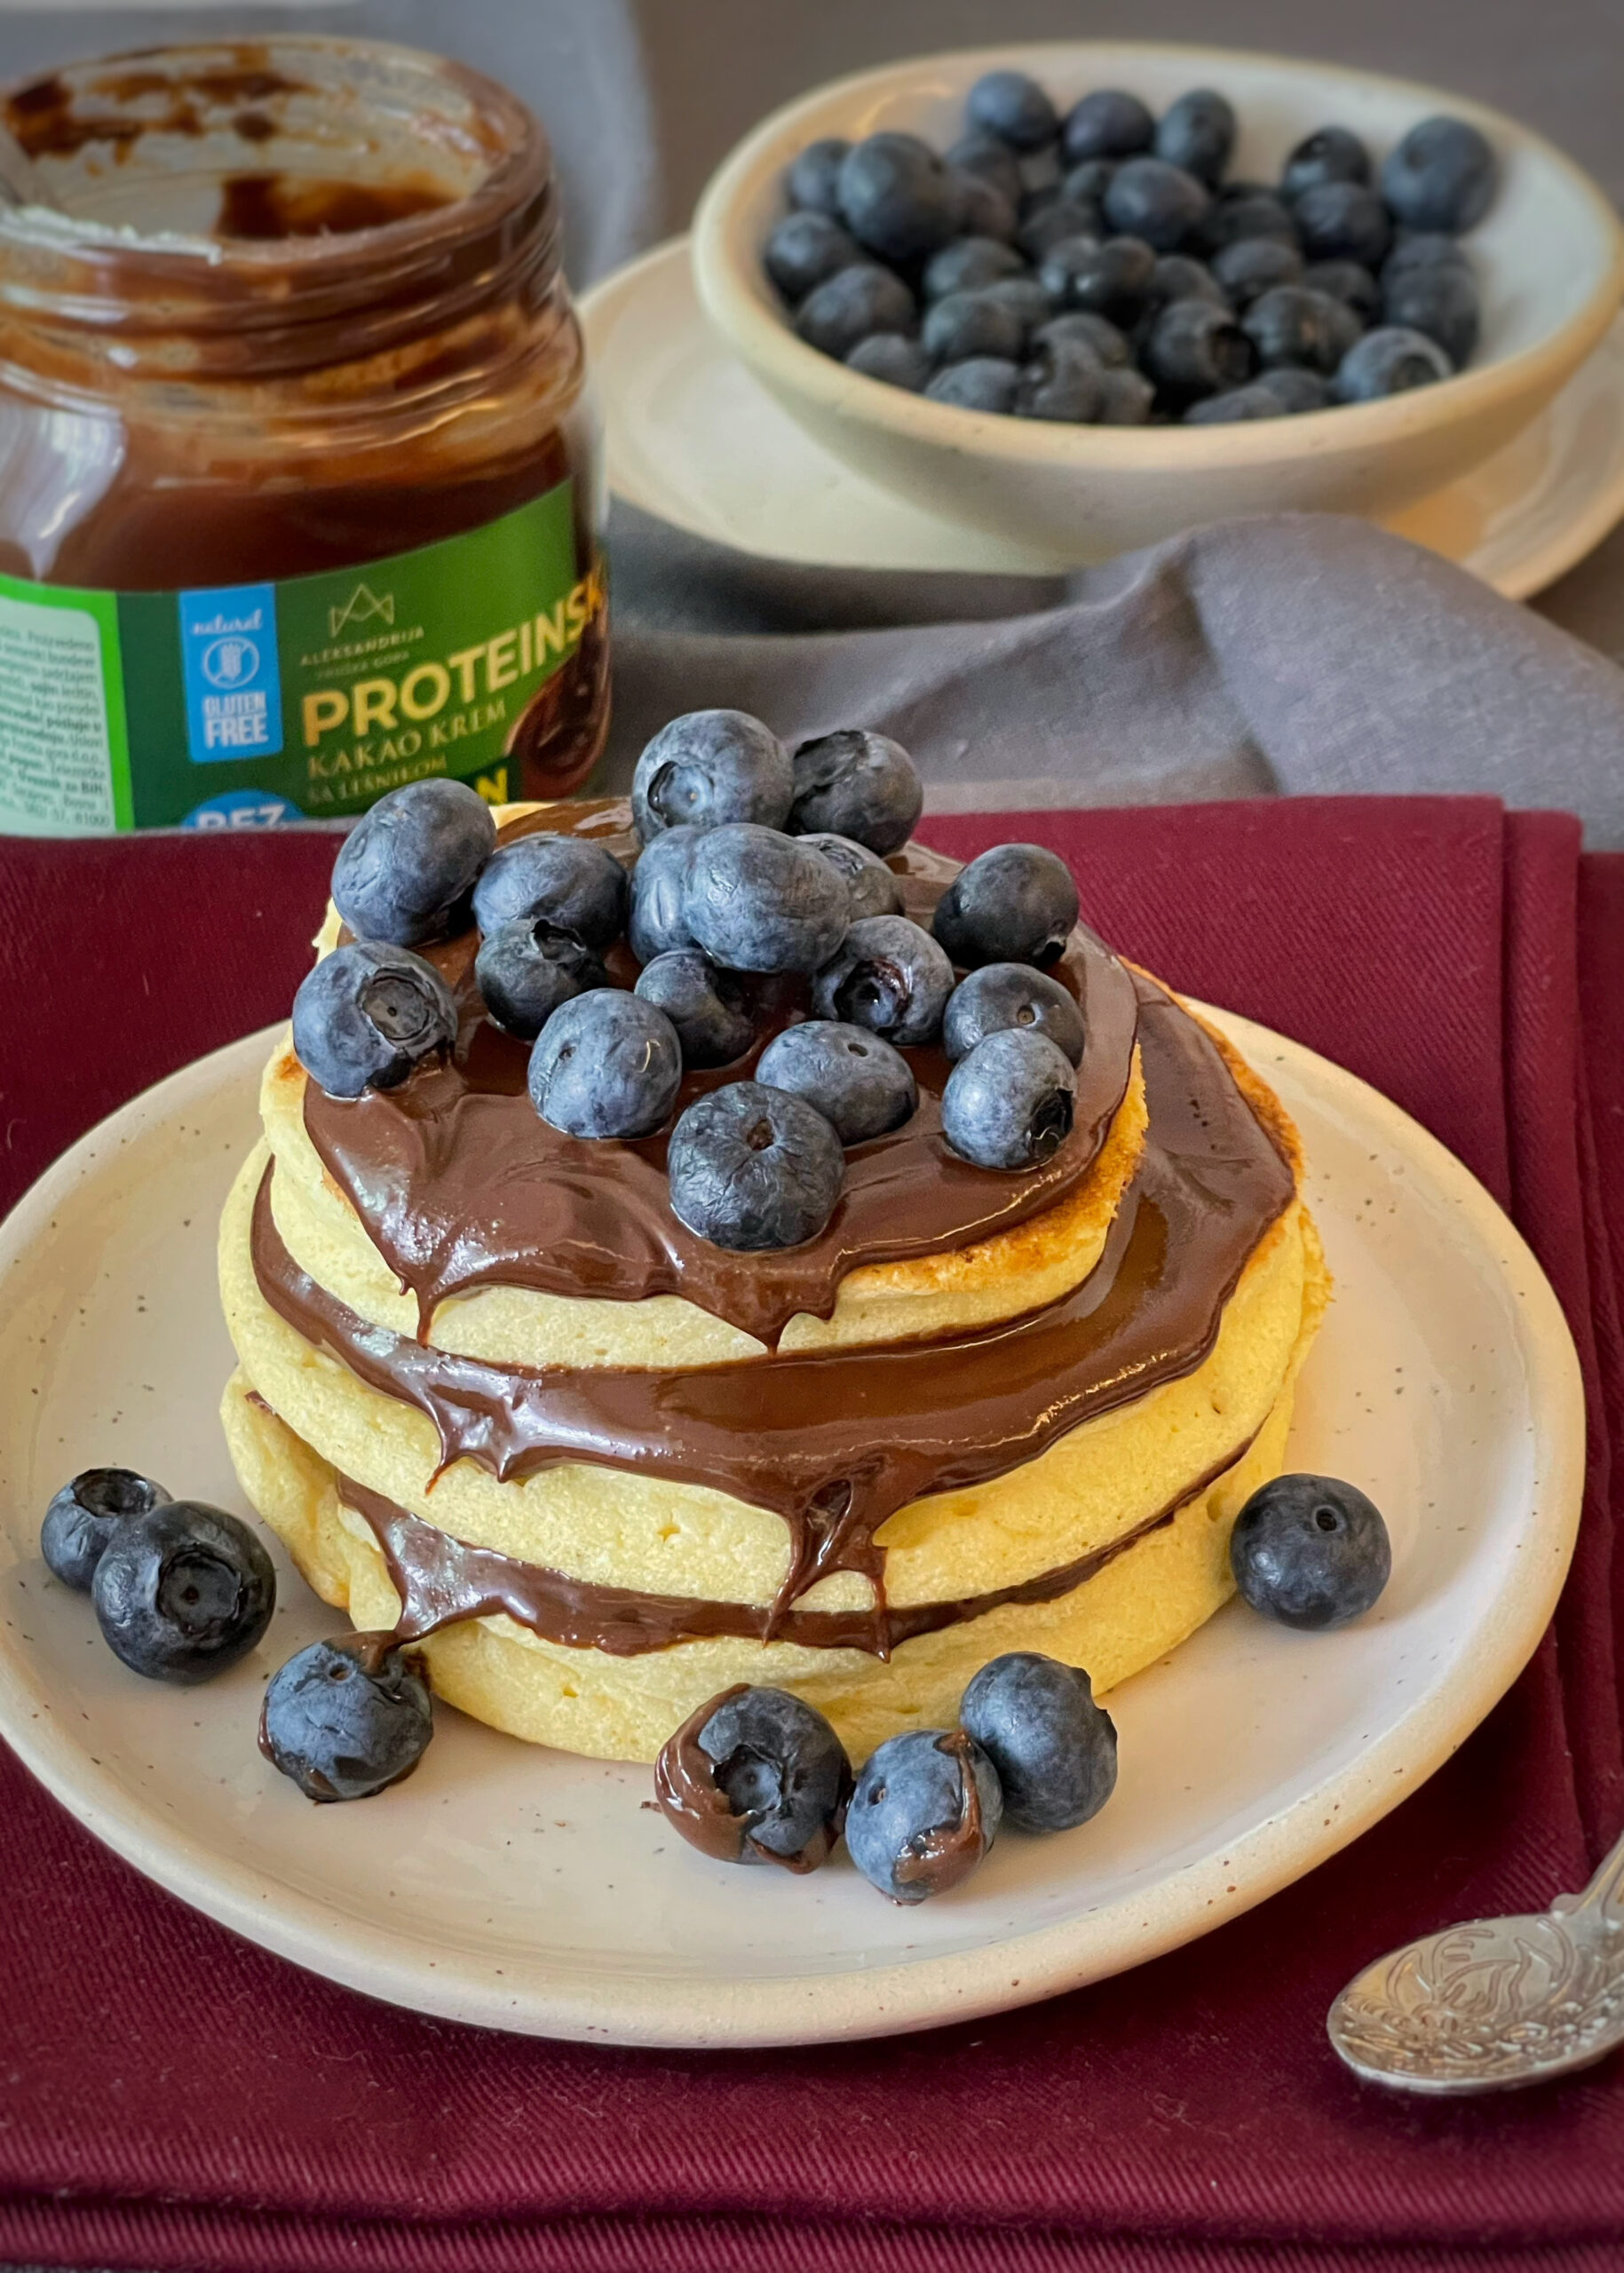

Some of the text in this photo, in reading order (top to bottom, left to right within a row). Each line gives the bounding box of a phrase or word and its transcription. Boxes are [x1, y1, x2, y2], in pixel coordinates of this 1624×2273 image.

[192, 608, 262, 636] natural
[300, 625, 425, 666] ALEKSANDRIJA
[203, 690, 266, 717] GLUTEN
[205, 713, 269, 750] FREE
[309, 699, 507, 779] KAKAO KREM
